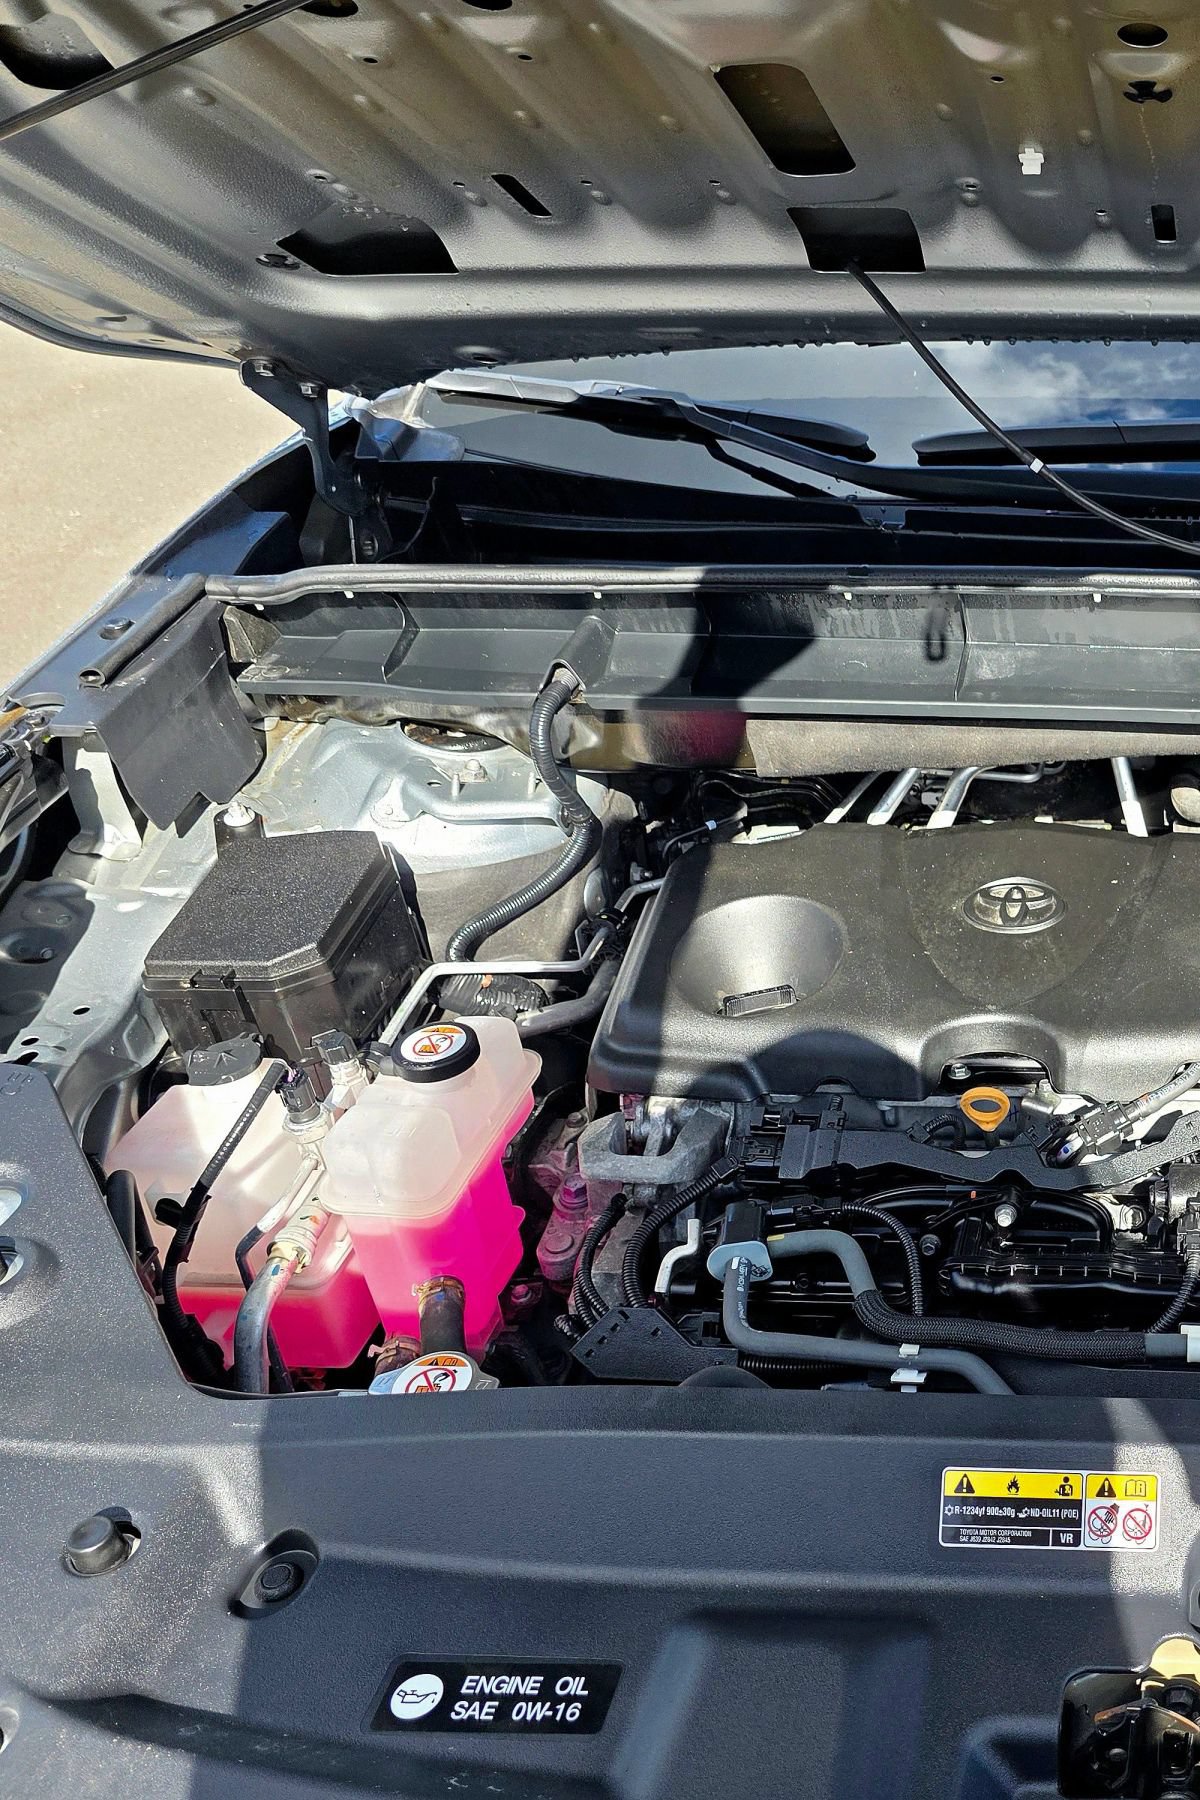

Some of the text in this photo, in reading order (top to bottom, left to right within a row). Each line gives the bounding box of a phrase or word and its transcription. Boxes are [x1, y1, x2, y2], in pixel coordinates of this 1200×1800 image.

[959, 1528, 979, 1536] TOYOTA
[997, 1529, 1032, 1537] CORPORATION
[1059, 1532, 1074, 1544] VR
[460, 1675, 589, 1696] ENGINE OIL
[450, 1700, 582, 1722] SAE 0W-16
